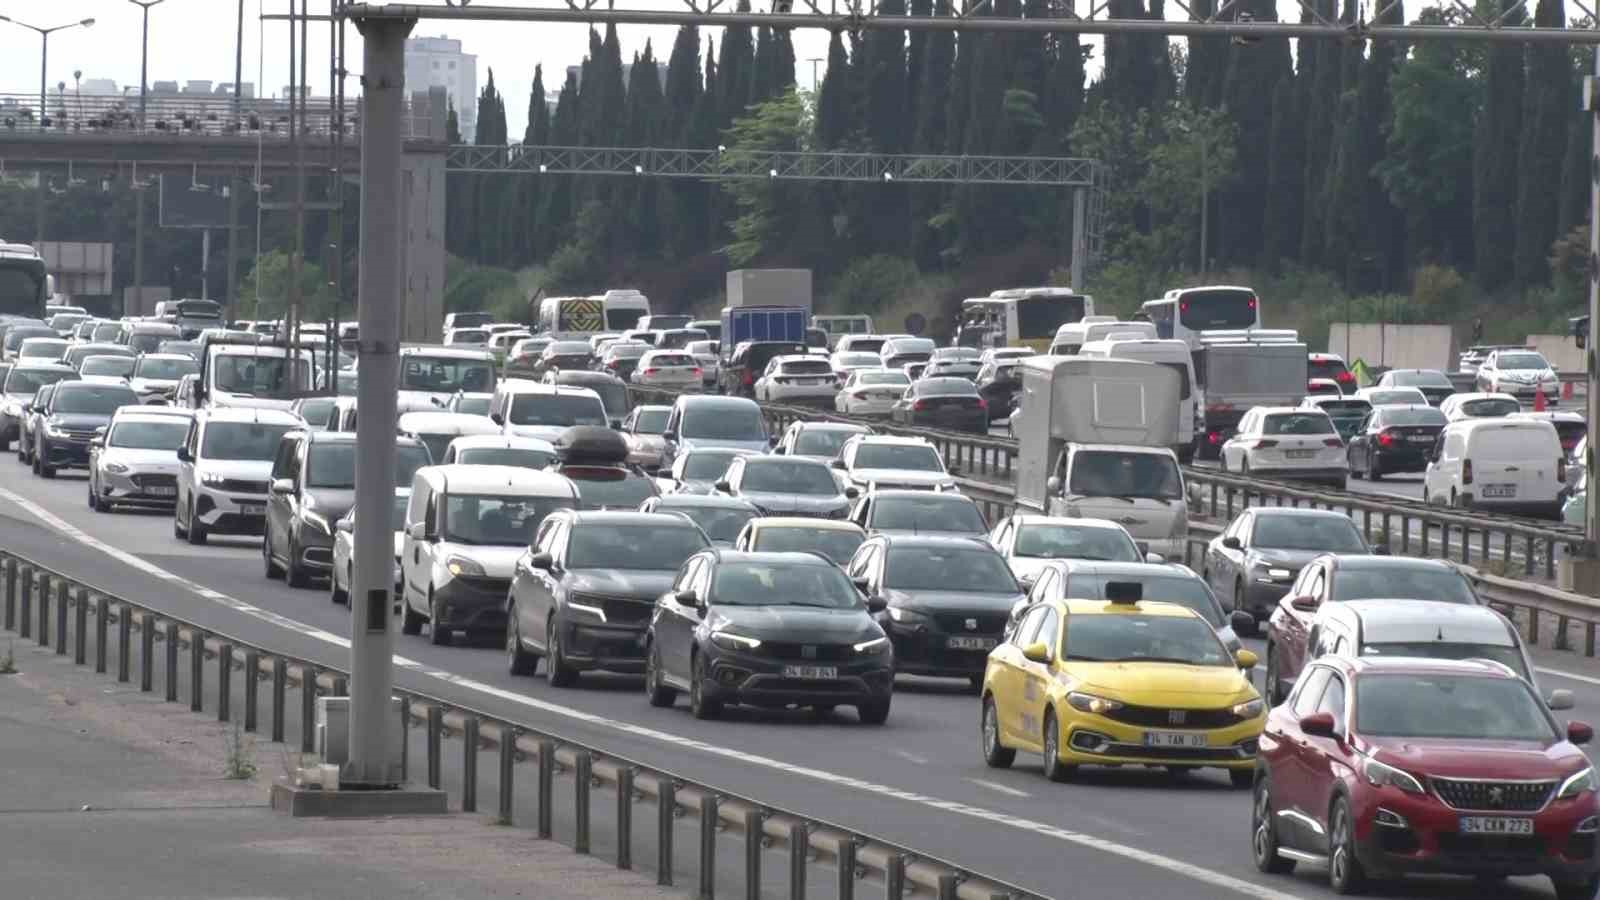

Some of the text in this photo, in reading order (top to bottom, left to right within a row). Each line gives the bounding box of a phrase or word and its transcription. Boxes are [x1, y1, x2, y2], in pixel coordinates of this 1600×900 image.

[1167, 735, 1185, 745] TAN
[1466, 817, 1481, 831] 34
[1508, 818, 1531, 833] 273
